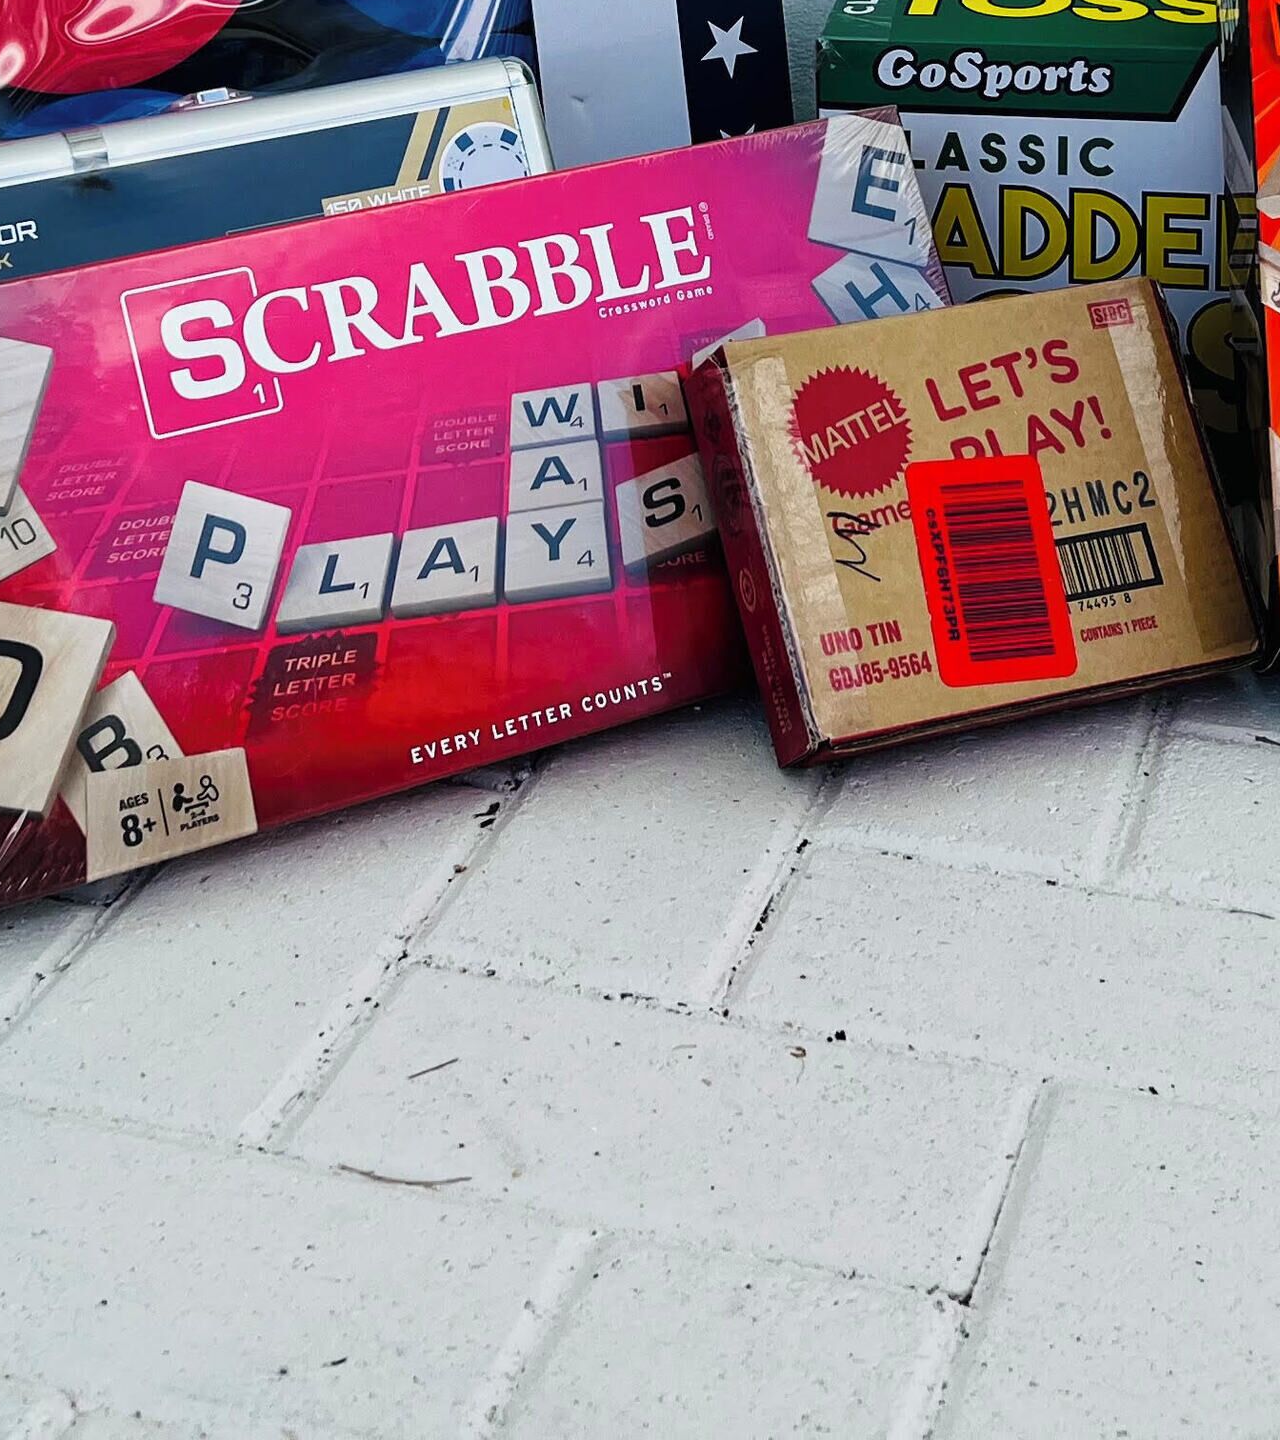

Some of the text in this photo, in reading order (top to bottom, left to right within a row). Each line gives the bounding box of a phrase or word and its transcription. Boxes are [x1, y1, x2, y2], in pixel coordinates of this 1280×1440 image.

[877, 48, 1112, 98] GoSports
[851, 144, 906, 222] E
[161, 206, 711, 400] SCRABBLE
[598, 285, 713, 319] Crossword Game
[925, 339, 1080, 422] LET'S
[433, 413, 498, 429] DOUBLE
[433, 426, 494, 441] LETTER
[797, 398, 908, 465] MATTEL
[435, 439, 491, 454] SCORE
[45, 485, 105, 502] SCORE
[51, 471, 117, 488] LETTER
[831, 500, 912, 539] Game
[112, 530, 170, 546] LETTE
[1131, 615, 1158, 632] PIECE
[820, 620, 903, 657] UNO TIN
[285, 650, 357, 672] TRIPLE
[829, 650, 933, 692] GDJ85-9564
[274, 673, 356, 696] LETTER
[410, 729, 481, 765] EVERY
[491, 703, 572, 741] LETTER
[119, 792, 149, 812] AGES
[121, 812, 156, 847] 8+
[180, 813, 220, 832] PLAYERS
